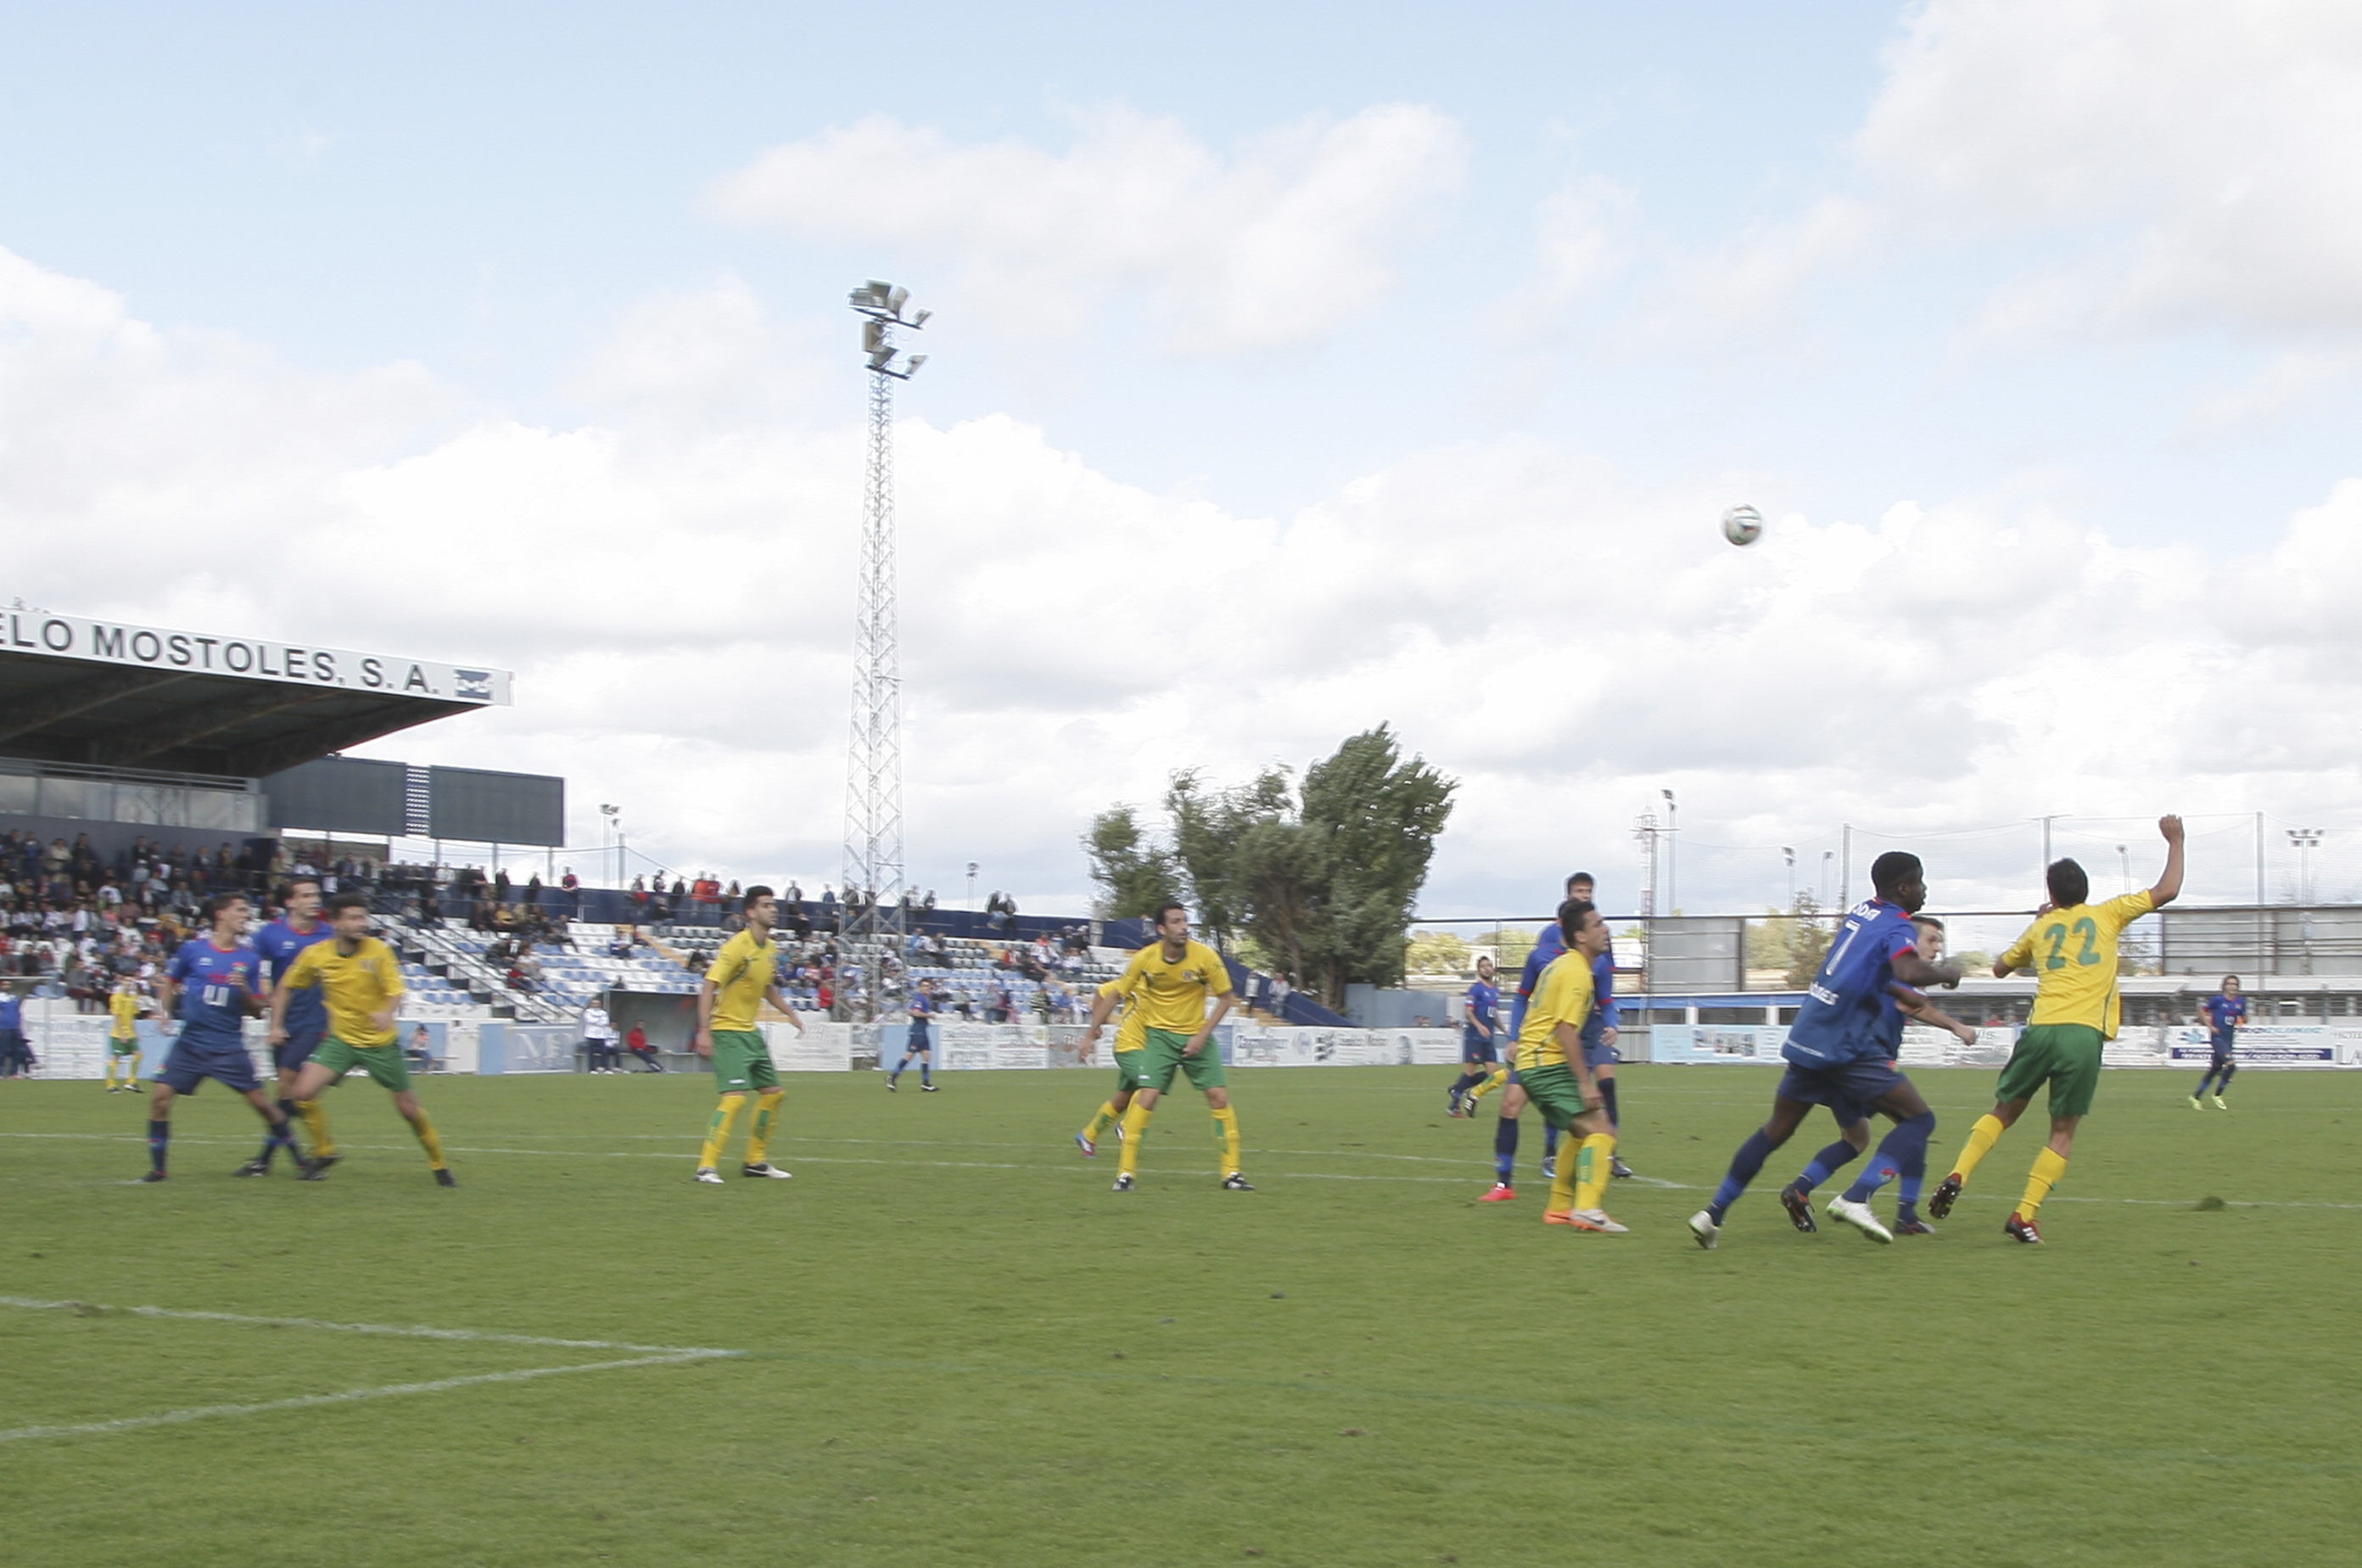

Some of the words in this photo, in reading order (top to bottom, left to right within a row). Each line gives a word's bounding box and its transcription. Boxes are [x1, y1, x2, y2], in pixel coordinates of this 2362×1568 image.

[0, 613, 71, 652] LO
[92, 624, 345, 686] MOSTOLES,
[361, 658, 395, 689] S.
[403, 664, 439, 695] A.
[1826, 919, 1861, 976] 7
[2044, 917, 2101, 971] 22
